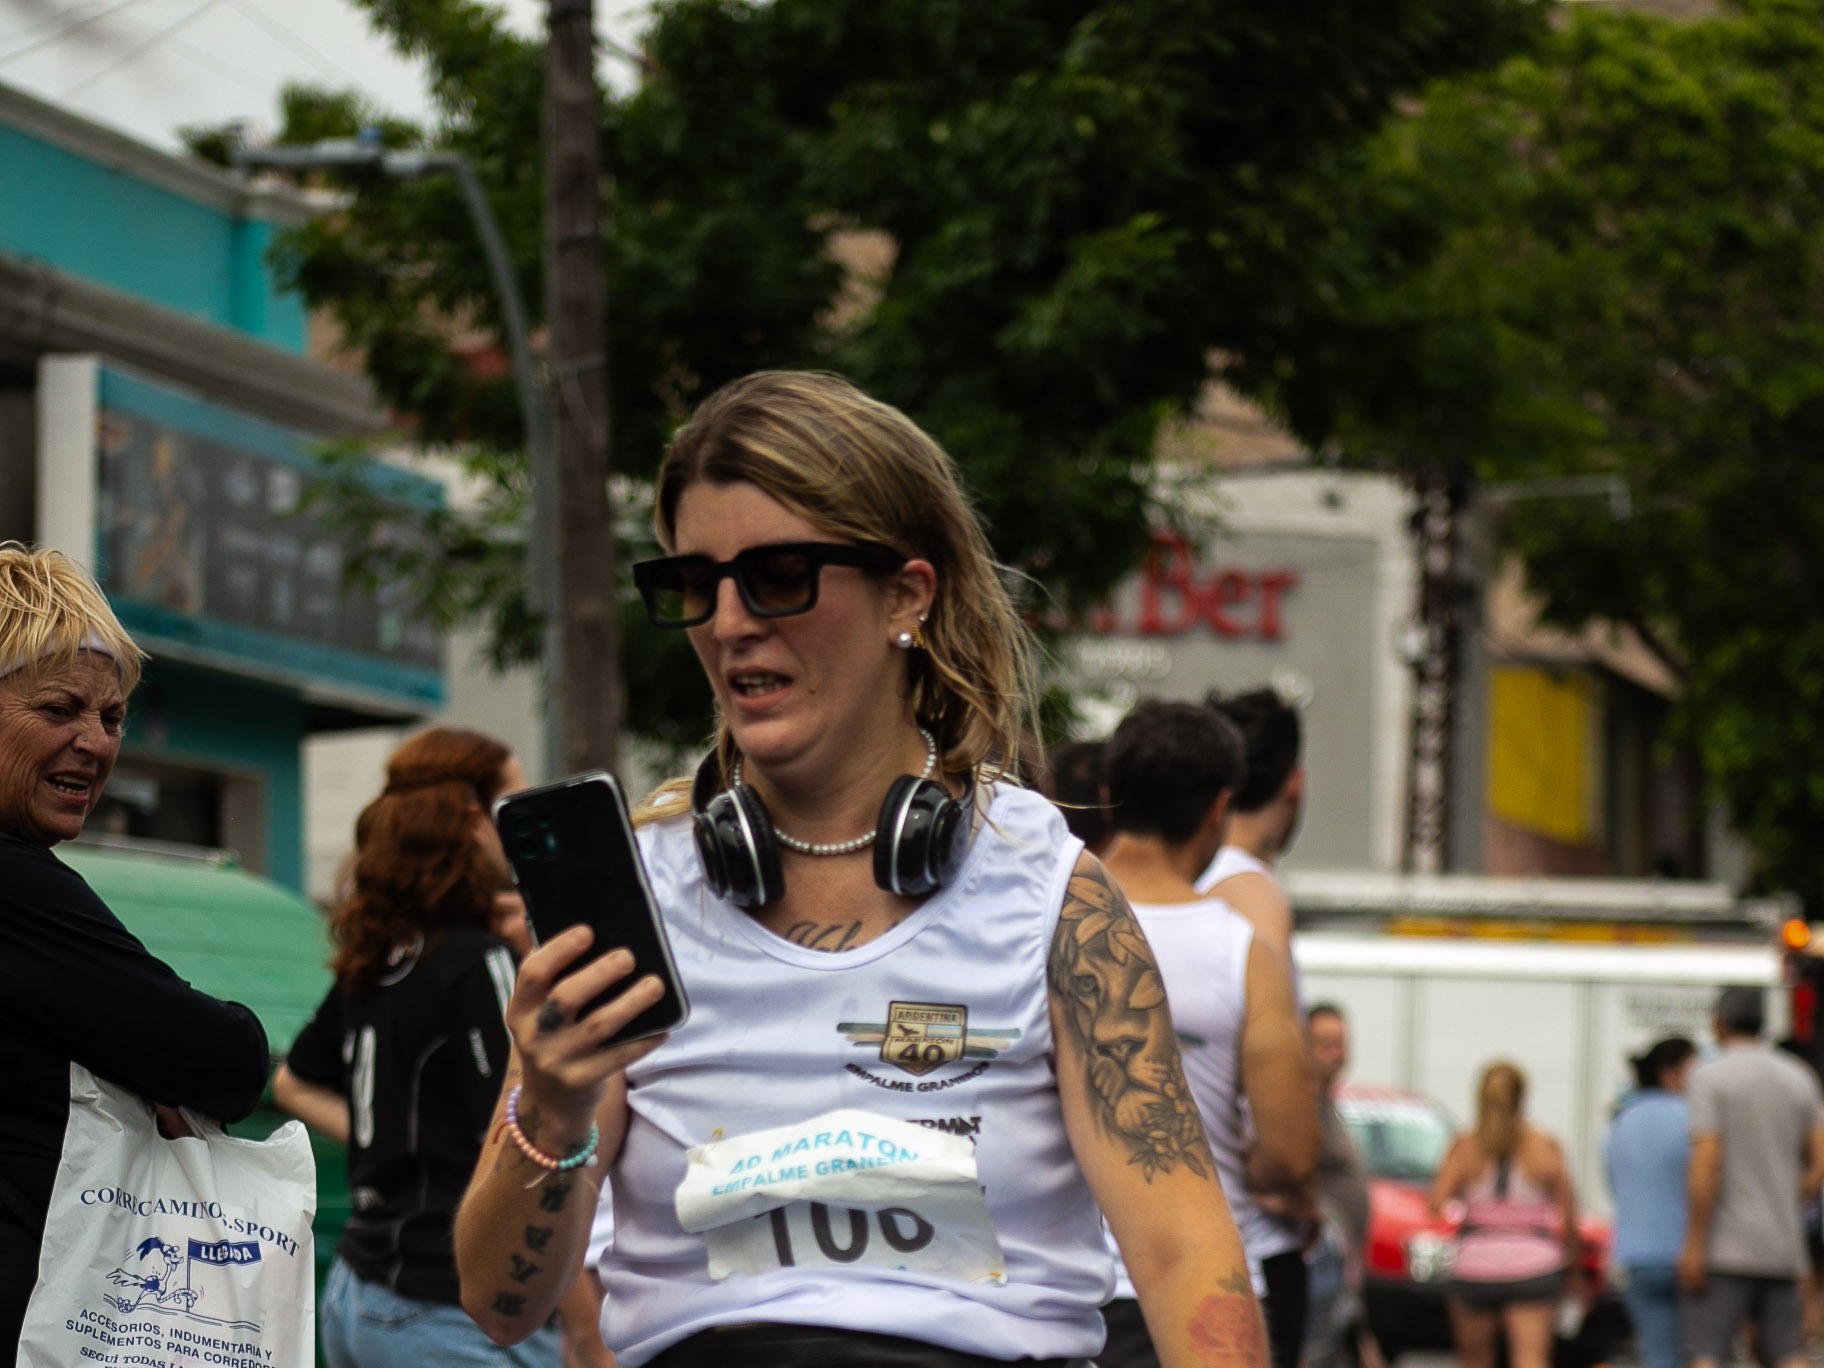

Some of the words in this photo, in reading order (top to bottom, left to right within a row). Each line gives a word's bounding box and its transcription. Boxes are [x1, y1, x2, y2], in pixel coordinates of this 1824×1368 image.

[897, 1010, 958, 1023] ARGENTINA
[898, 1043, 945, 1063] 40
[844, 1062, 914, 1093] EMPALME
[916, 1060, 991, 1093] GRANEROS
[712, 1164, 809, 1196] EMPALME
[200, 1244, 253, 1262] LLEGADA
[65, 1319, 161, 1350] SUPLEMENTOS
[167, 1342, 200, 1359] PARA
[80, 1308, 164, 1338] ACCESORIOS,
[170, 1328, 262, 1359] INDUMENTARIA
[265, 1349, 272, 1361] Y
[123, 1355, 165, 1368] TODAS
